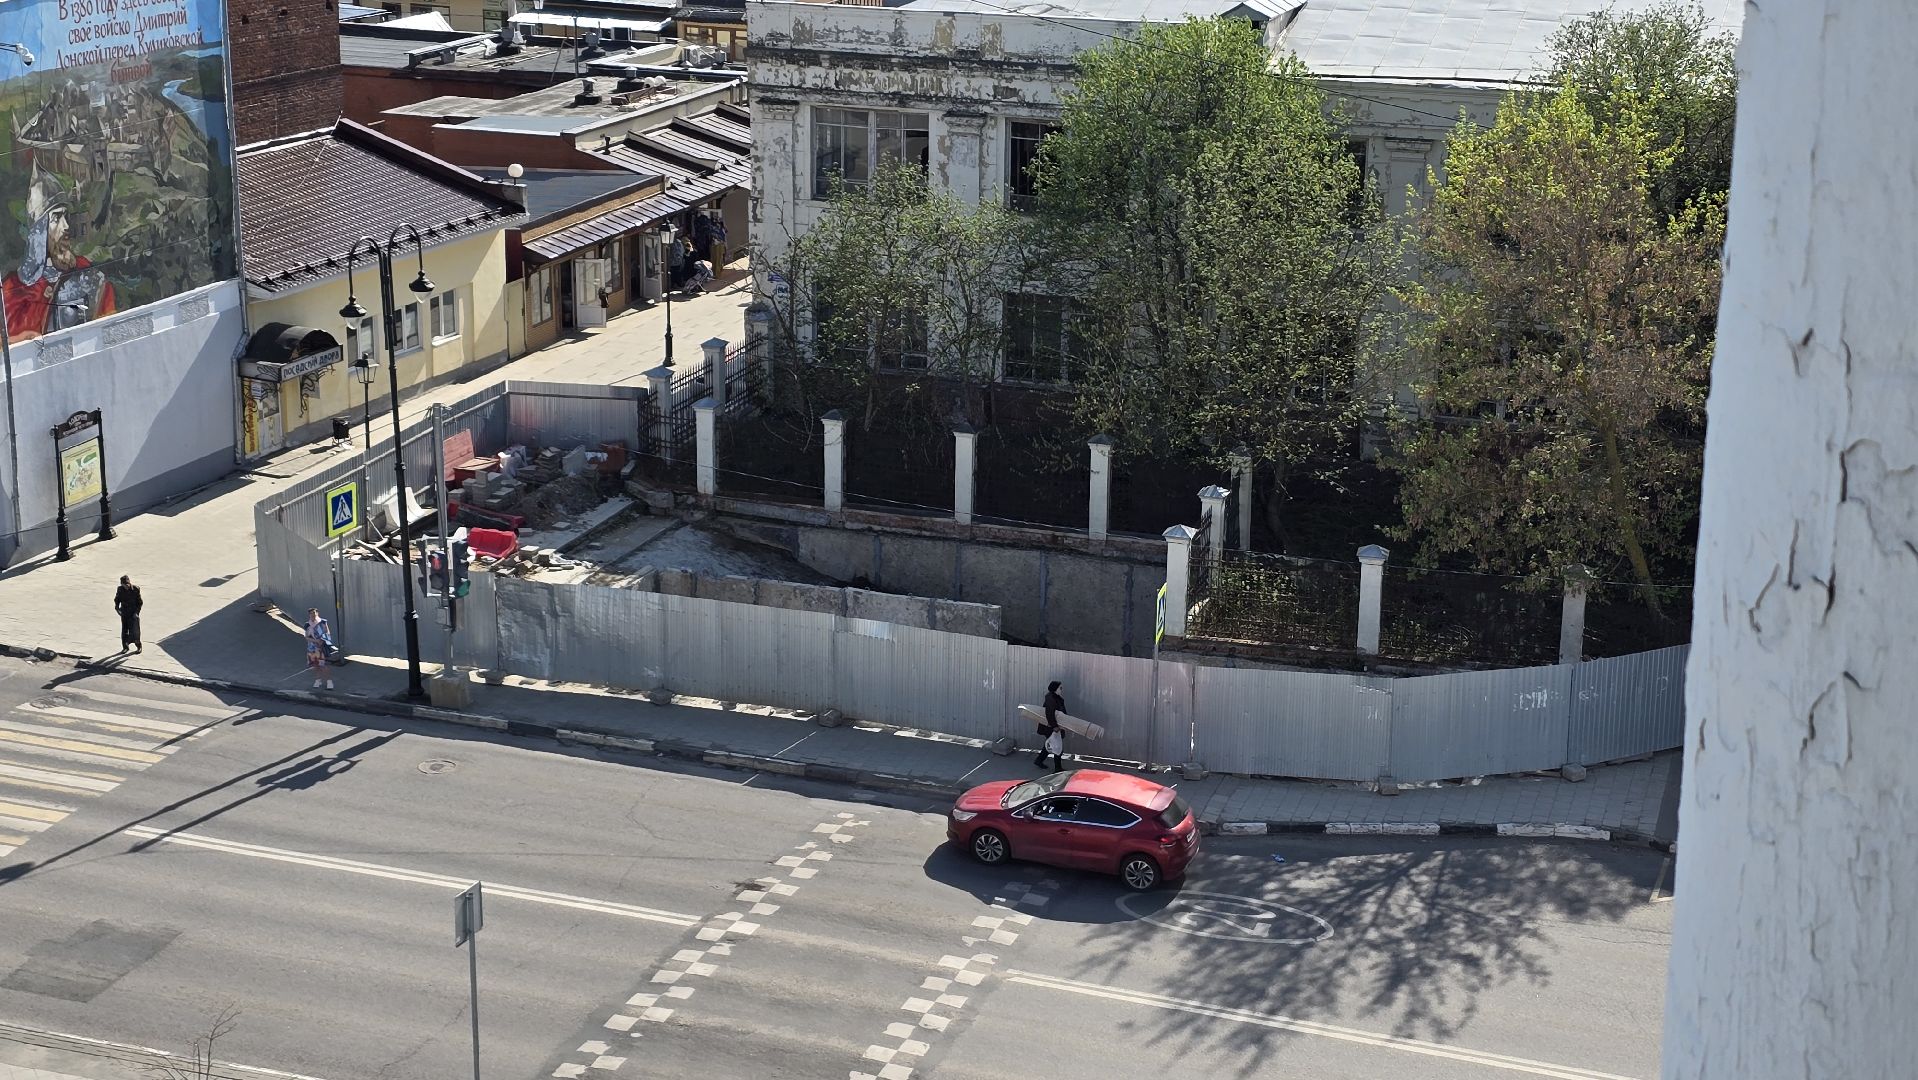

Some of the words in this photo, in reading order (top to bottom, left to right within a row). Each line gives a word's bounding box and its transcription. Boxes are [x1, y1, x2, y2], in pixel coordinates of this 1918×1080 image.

[58, 0, 69, 20] В
[70, 0, 93, 23] 1380
[68, 21, 92, 45] своё
[94, 18, 131, 39] войско
[134, 6, 187, 37] Дмитрий
[55, 44, 104, 72] Донской
[104, 44, 136, 66] перед
[137, 28, 204, 57] Куликовской
[111, 59, 152, 82] битвой
